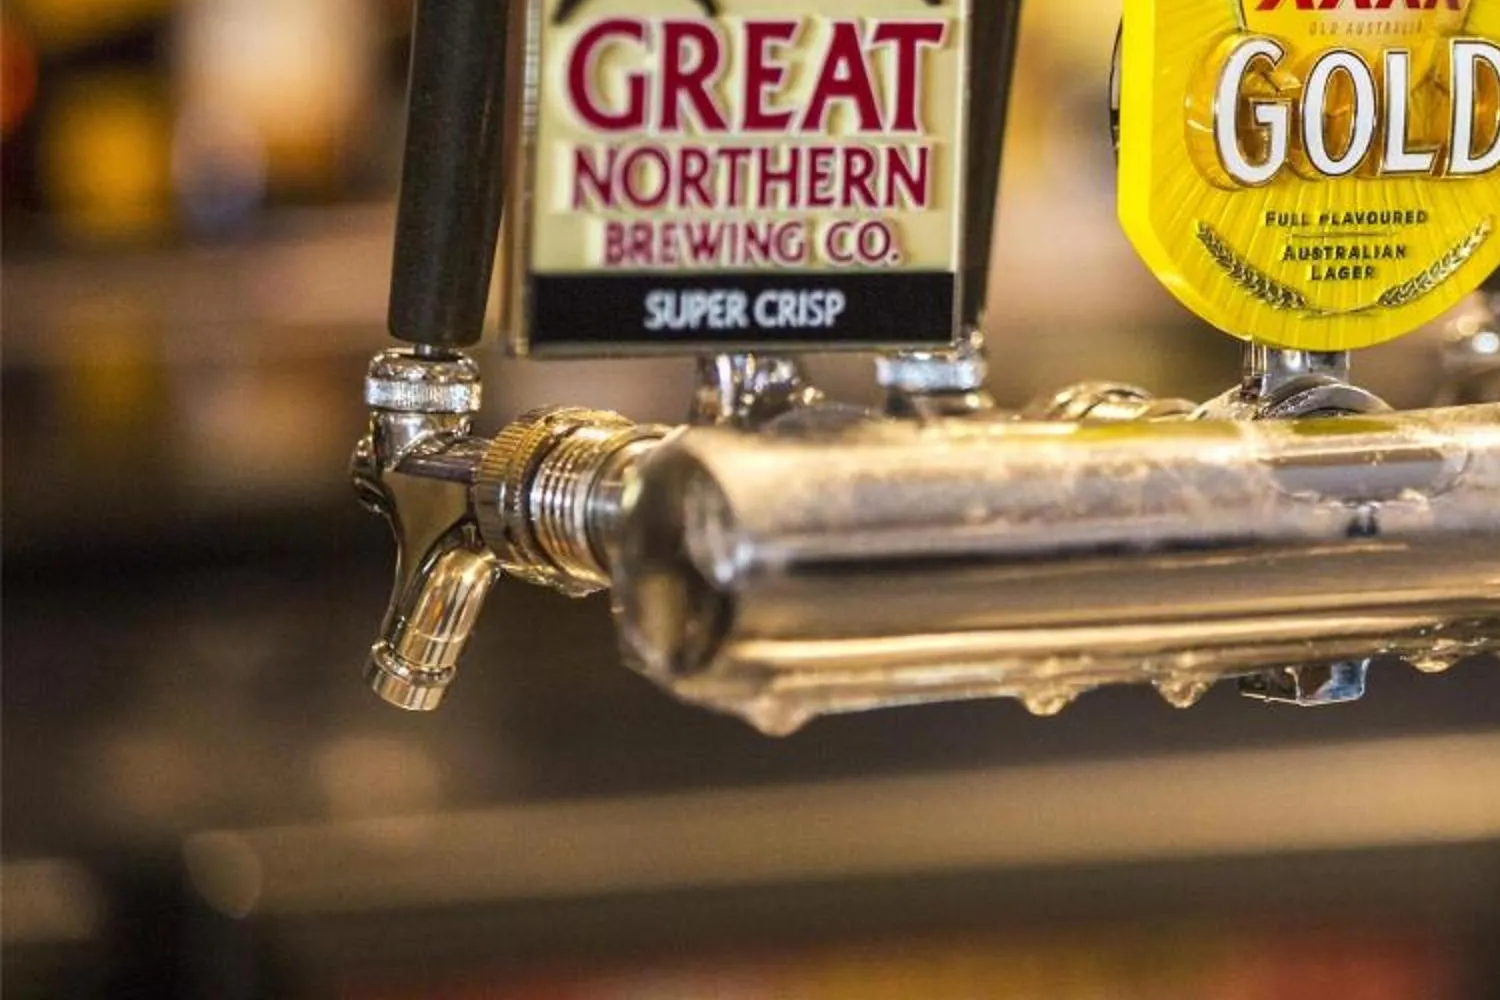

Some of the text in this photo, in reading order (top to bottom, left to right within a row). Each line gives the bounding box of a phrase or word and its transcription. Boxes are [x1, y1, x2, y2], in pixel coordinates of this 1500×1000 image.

[565, 18, 946, 134] GREAT
[571, 146, 929, 210] NORTHERN
[1264, 209, 1430, 227] FULL FLAVOURED
[605, 221, 900, 266] BREWING CO.
[1282, 243, 1408, 262] AUSTRALIAN
[1310, 265, 1377, 281] LAGER
[643, 290, 846, 331] SUPER CRISP
